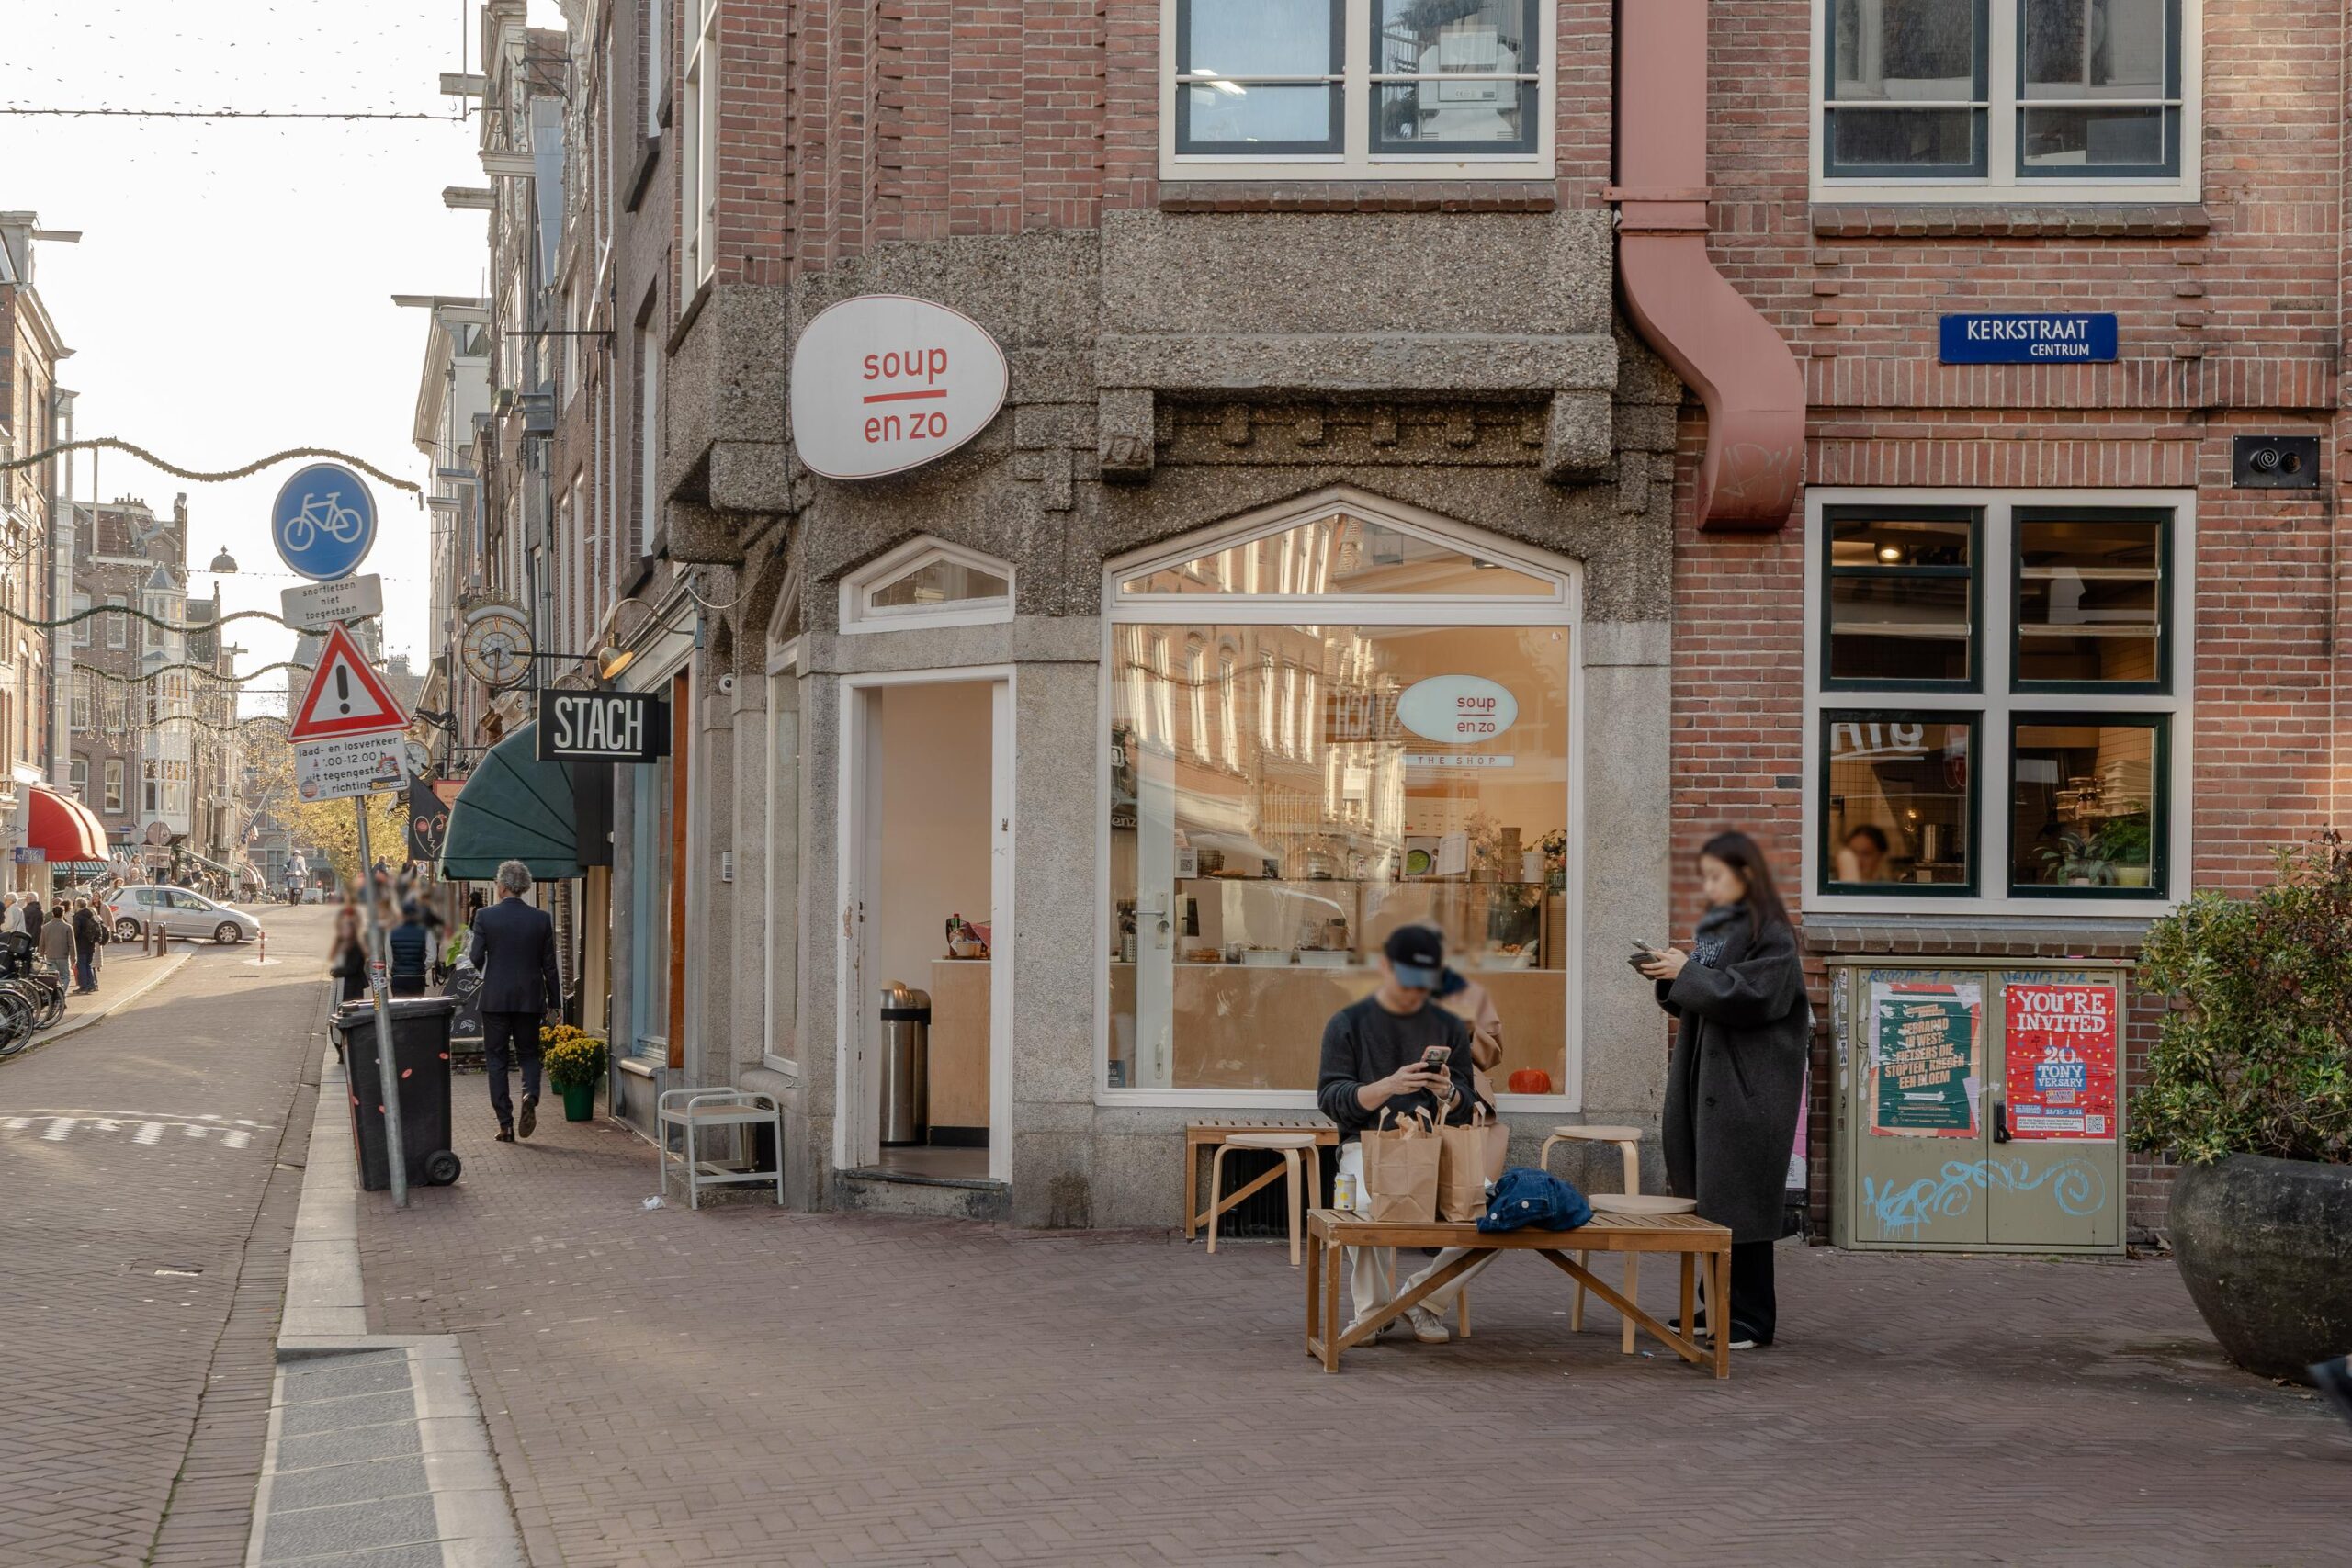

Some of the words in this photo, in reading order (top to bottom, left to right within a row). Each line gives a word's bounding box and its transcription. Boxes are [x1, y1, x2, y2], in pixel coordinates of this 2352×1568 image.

[1967, 320, 2089, 340] KERKSTRAAT
[2030, 344, 2089, 355] CENTRUM
[864, 347, 947, 385] soup
[302, 581, 356, 597] snorfietsen
[321, 596, 340, 605] niet
[305, 605, 357, 620] toegestaan
[1456, 697, 1496, 711] soup
[553, 696, 643, 750] STACH
[299, 746, 324, 757] laad-
[328, 745, 341, 753] en
[345, 737, 398, 750] losverkeer
[322, 751, 377, 767] .00-12.00
[1456, 757, 1496, 765] SHOP
[323, 766, 379, 781] tegengeste
[332, 780, 372, 793] richting
[2016, 991, 2106, 1015] YOU'RE
[2016, 1012, 2106, 1033] INVITED
[1905, 1035, 1916, 1047] IN
[1917, 1032, 1945, 1046] WEST:
[1896, 1045, 1938, 1062] FIETSERS
[1939, 1043, 1954, 1057] DIE
[2038, 1065, 2084, 1078] TONY
[1899, 1075, 1917, 1089] EEN
[1917, 1070, 1951, 1086] BLOEM
[2038, 1078, 2083, 1088] VERSARY
